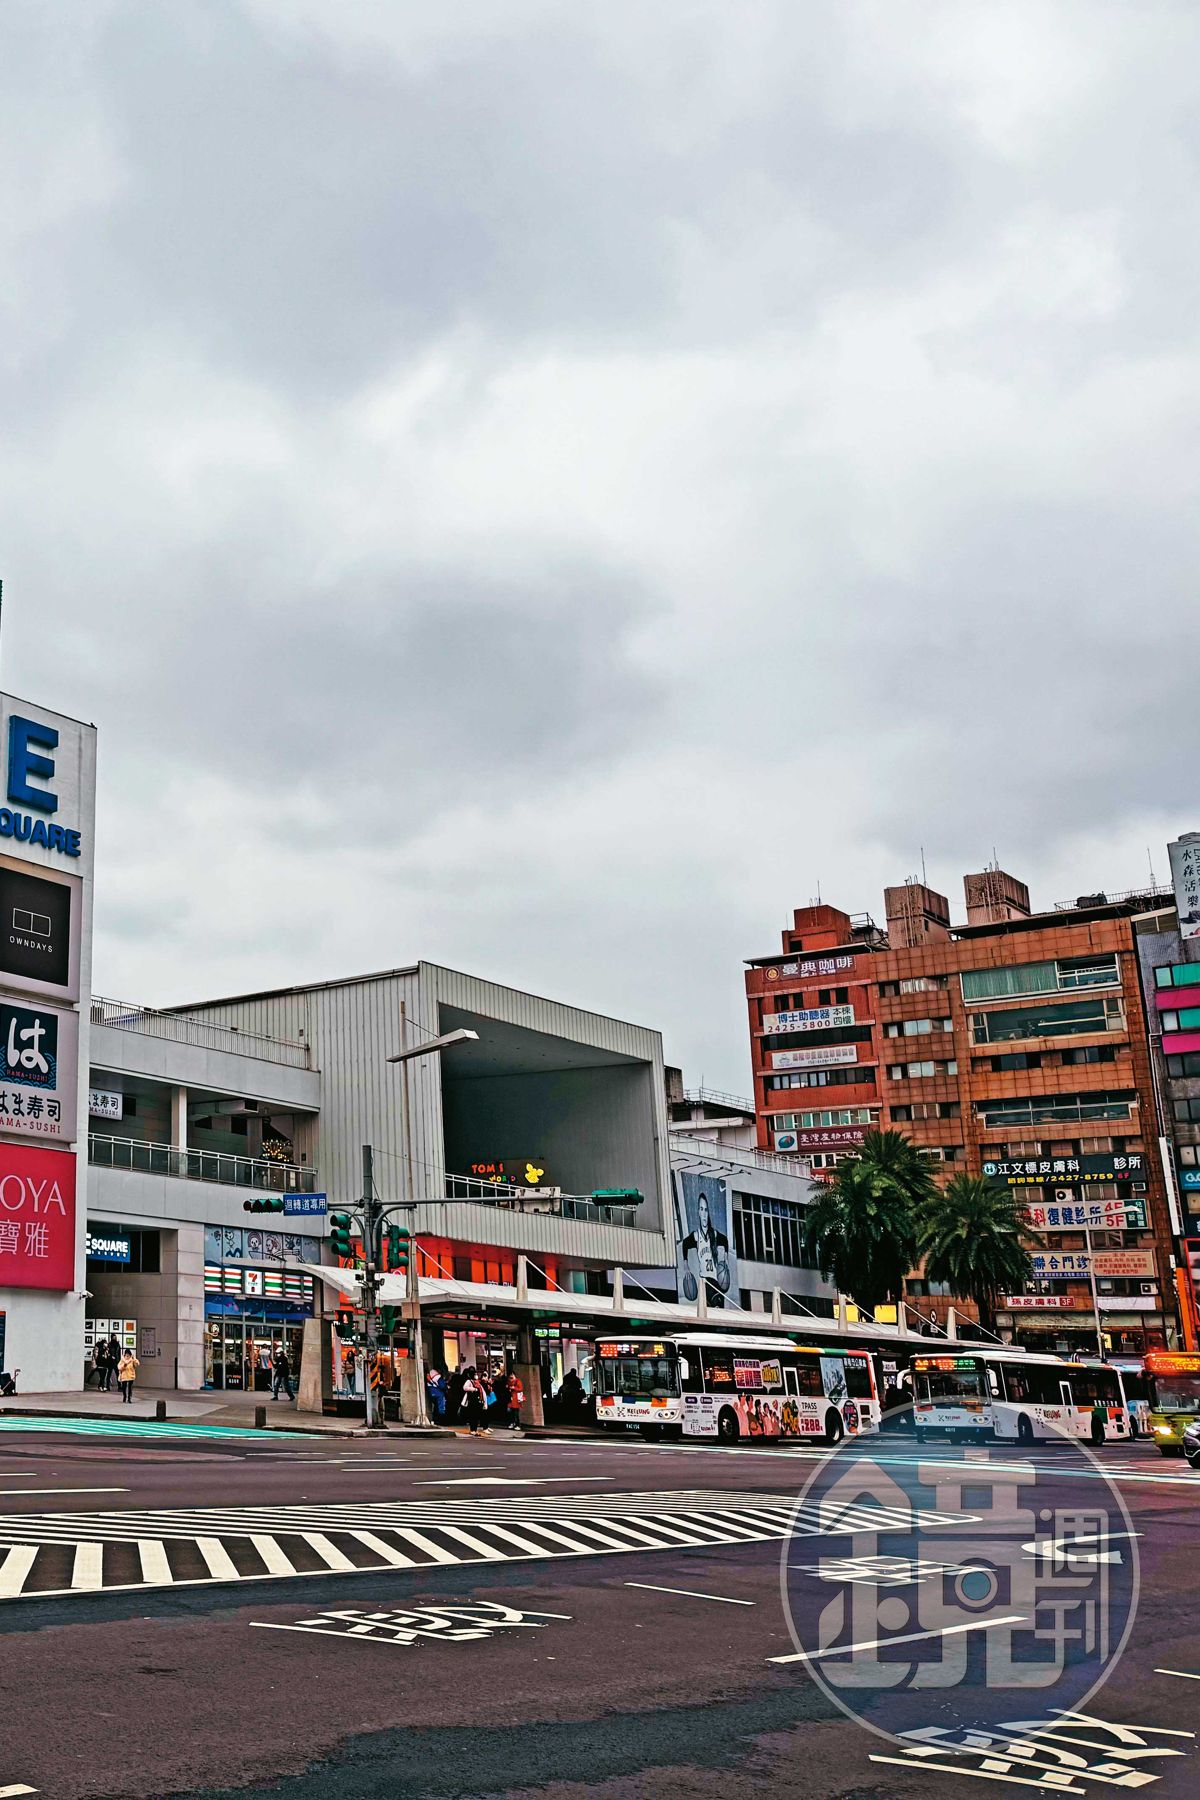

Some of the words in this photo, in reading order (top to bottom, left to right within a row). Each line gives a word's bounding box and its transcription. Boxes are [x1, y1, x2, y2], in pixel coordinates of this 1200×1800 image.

[7, 714, 59, 814] E
[9, 936, 53, 953] OWNDAYS
[768, 1020, 831, 1033] 2425-5800
[6, 1017, 49, 1074] は
[88, 1093, 119, 1110] ま寿司
[1114, 1156, 1142, 1170] 診所
[1106, 1214, 1125, 1227] 5F
[91, 1239, 129, 1253] SQUARE
